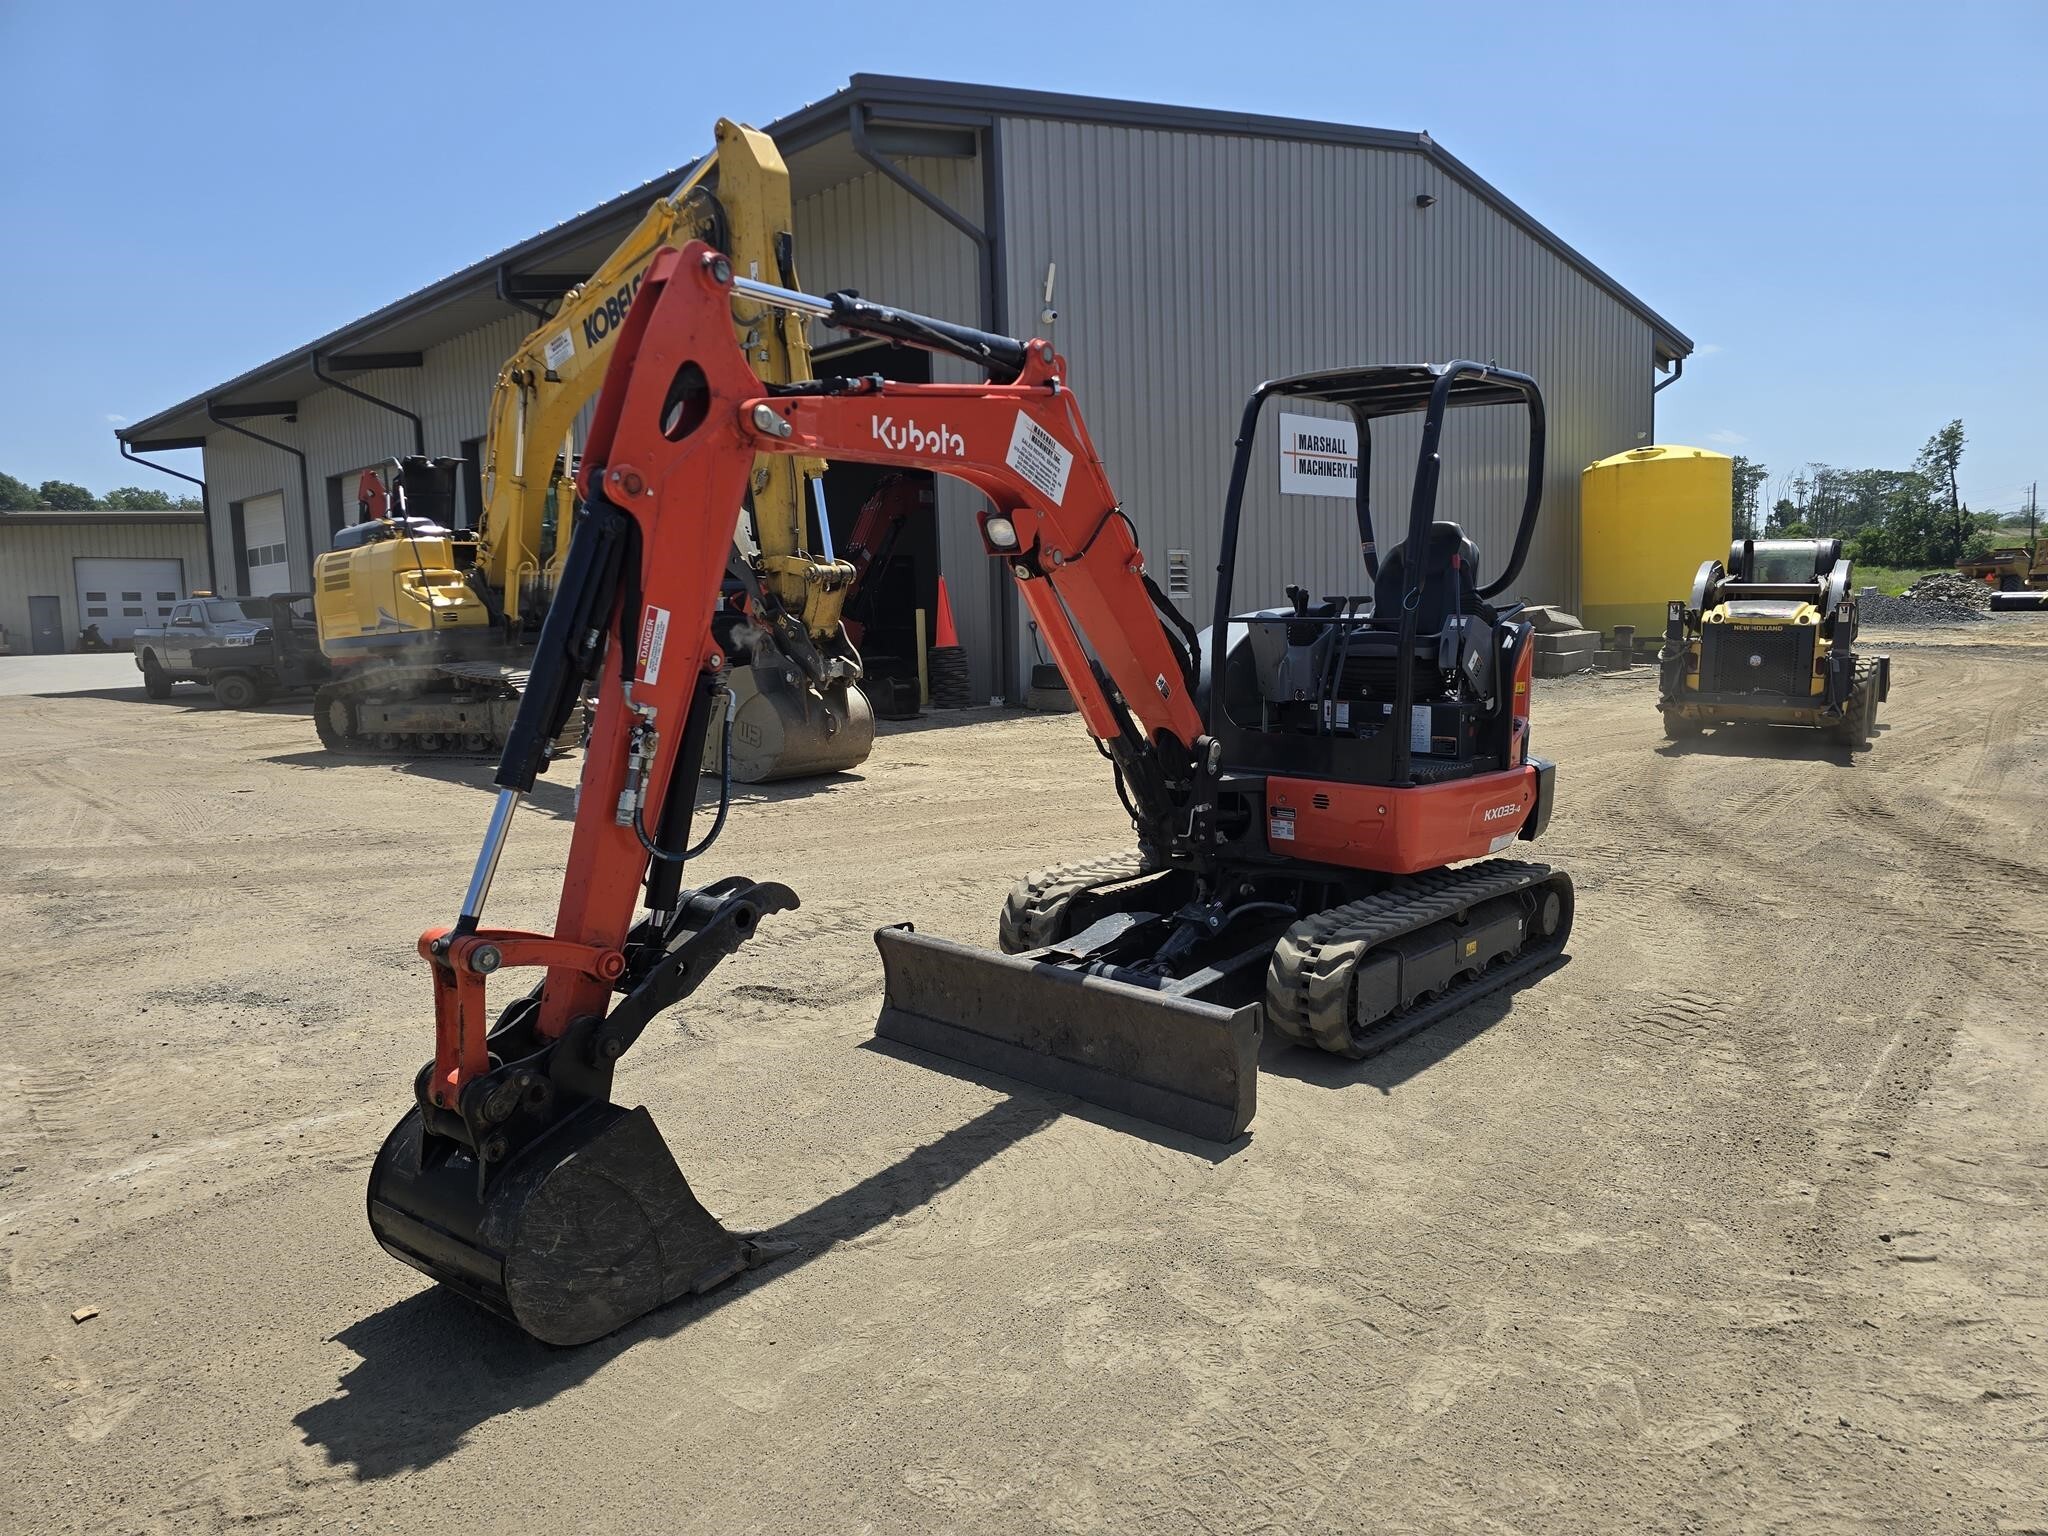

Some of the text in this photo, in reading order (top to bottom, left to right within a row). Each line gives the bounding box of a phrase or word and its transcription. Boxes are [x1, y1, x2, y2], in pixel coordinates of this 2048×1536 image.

[582, 266, 650, 348] KOBELC
[872, 414, 965, 456] Kubota
[1298, 434, 1347, 454] MARSHALL
[1350, 463, 1358, 479] In
[640, 618, 655, 657] DANGER
[1484, 804, 1521, 822] KX033-4
